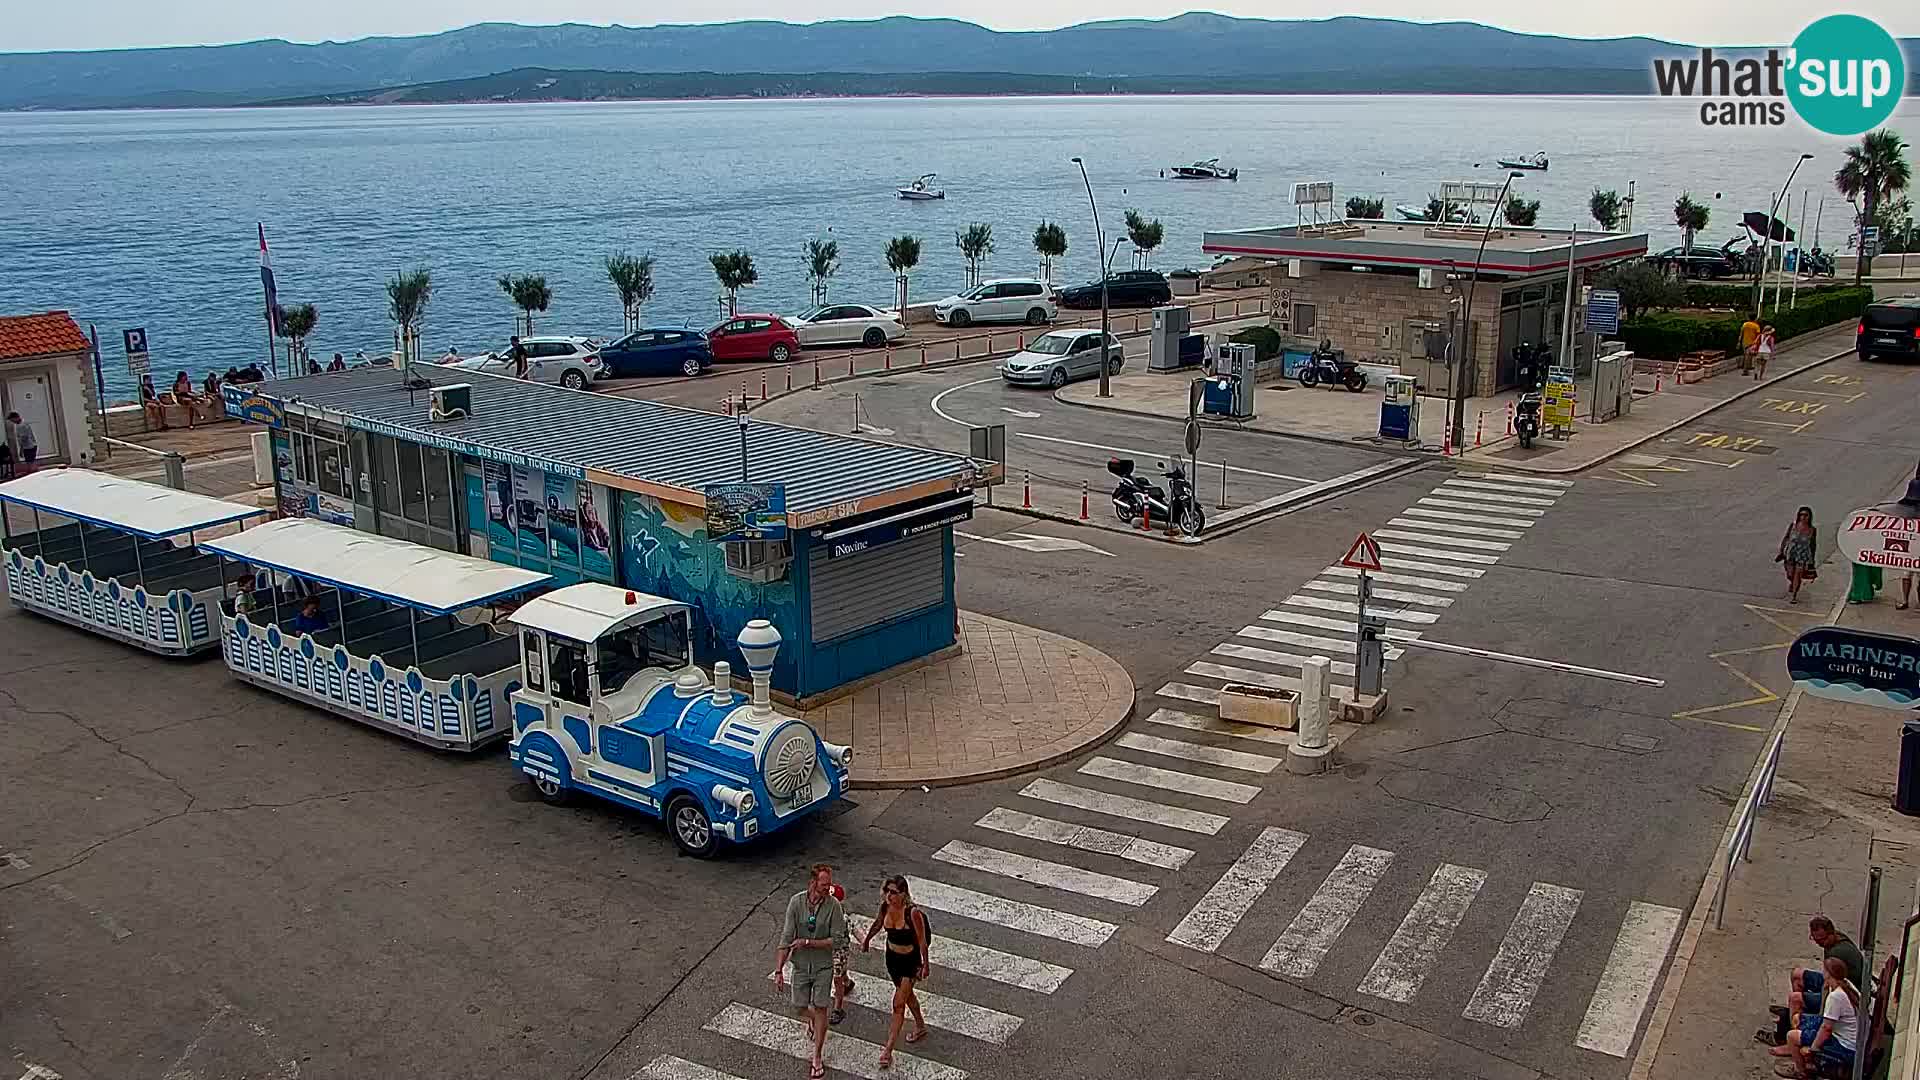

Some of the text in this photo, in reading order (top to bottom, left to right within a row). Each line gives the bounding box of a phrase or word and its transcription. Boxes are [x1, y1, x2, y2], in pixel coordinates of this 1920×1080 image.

[128, 331, 141, 350] P
[1760, 398, 1830, 415] TAXI
[1685, 432, 1764, 452] TAXI
[395, 428, 435, 446] AUTOBUSNA
[435, 437, 467, 452] POSTAJA
[477, 446, 492, 458] BUS
[493, 450, 525, 466] STATION
[527, 457, 553, 472] TICKET
[554, 463, 582, 477] OFFICE
[950, 512, 968, 522] CHOICE
[1881, 531, 1916, 540] GRILL
[1828, 663, 1896, 680] caffe bar
